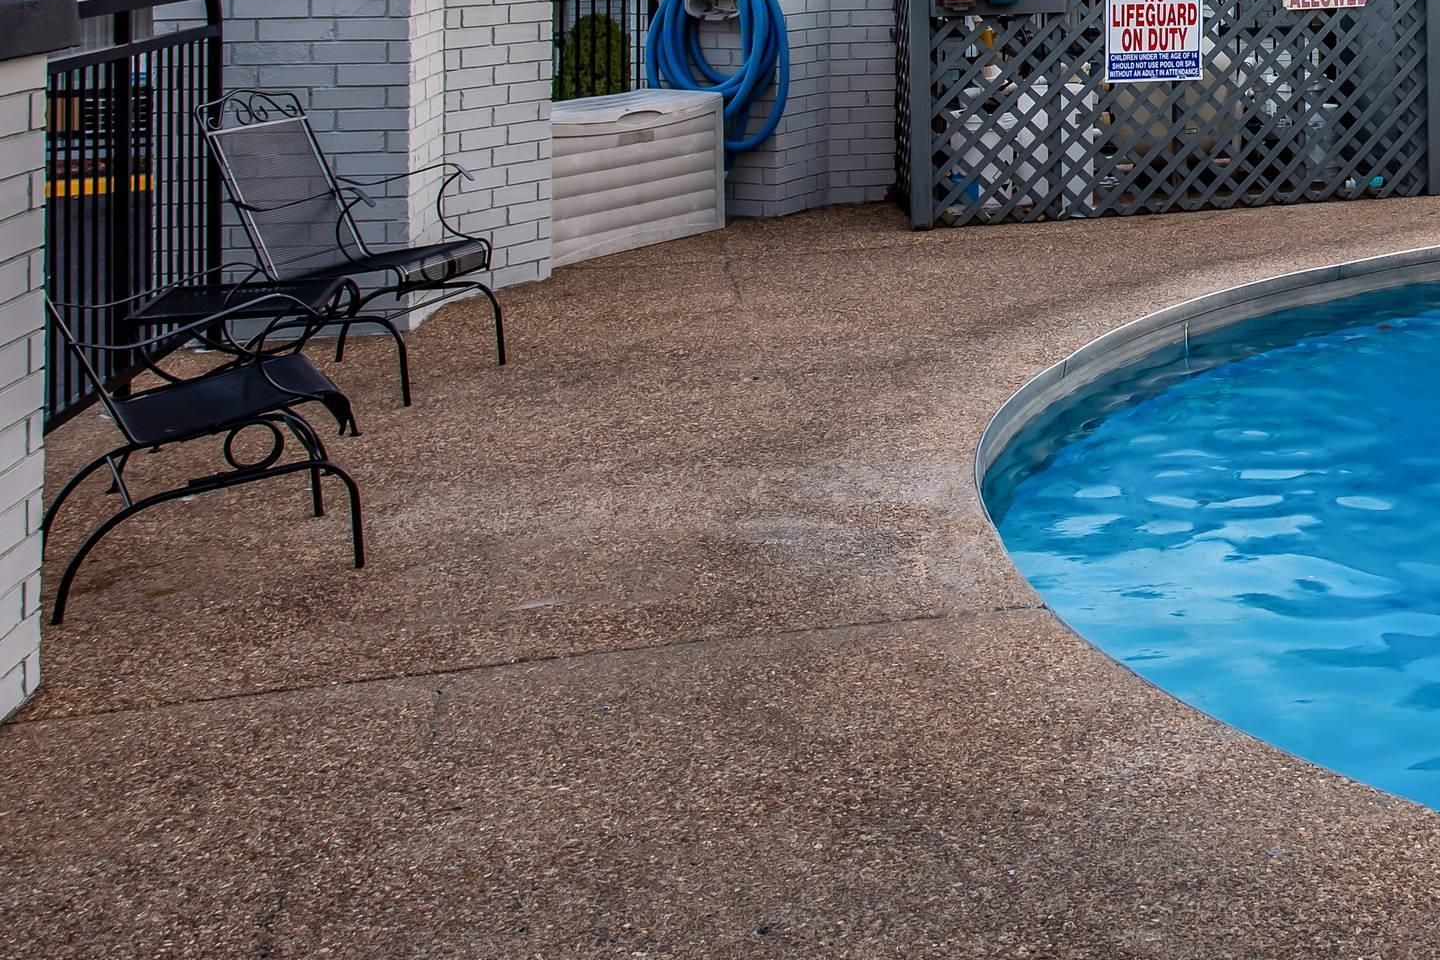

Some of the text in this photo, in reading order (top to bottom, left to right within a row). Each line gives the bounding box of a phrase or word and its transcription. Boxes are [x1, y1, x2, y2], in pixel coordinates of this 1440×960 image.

[1112, 3, 1197, 27] LIFEGUARD
[1122, 27, 1188, 52] ON DUTY
[1110, 70, 1132, 78] WITHOUT
[1142, 69, 1158, 77] ADULT
[1165, 68, 1199, 76] ATTENDANCE
